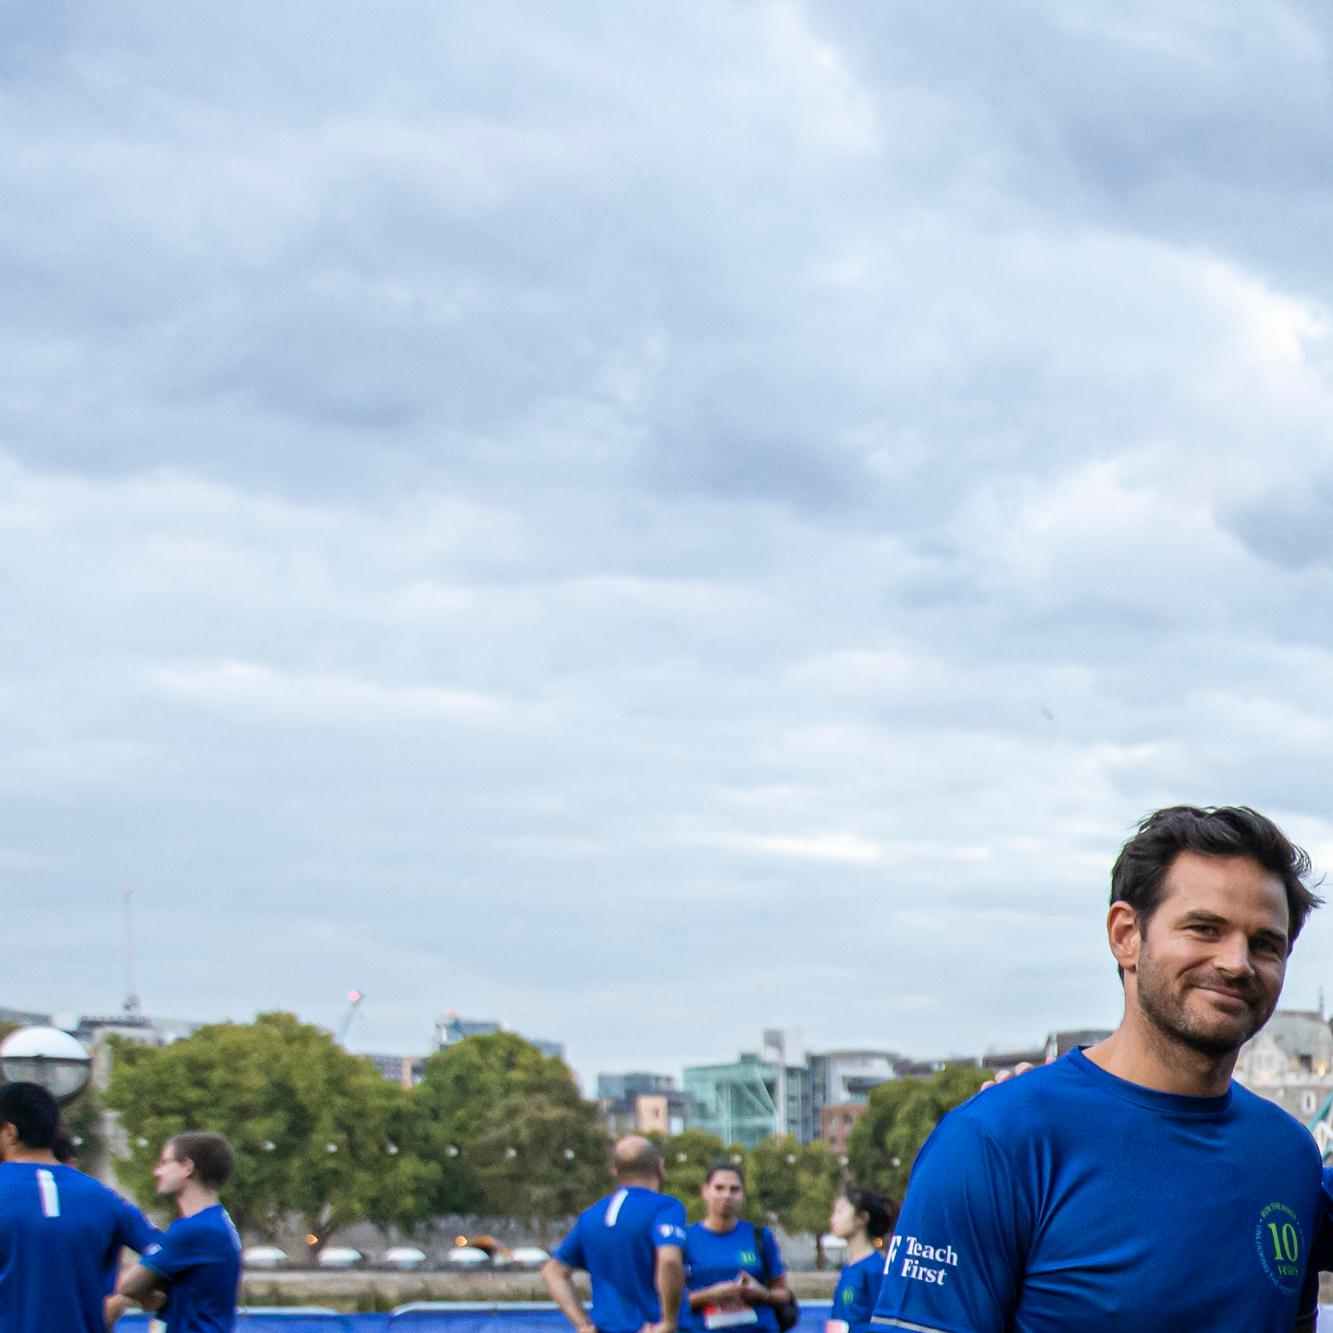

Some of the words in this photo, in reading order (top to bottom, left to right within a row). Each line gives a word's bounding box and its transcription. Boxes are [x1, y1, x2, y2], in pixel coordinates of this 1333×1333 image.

[906, 1236, 958, 1266] Teach
[1268, 1223, 1299, 1262] 10
[901, 1258, 947, 1285] First
